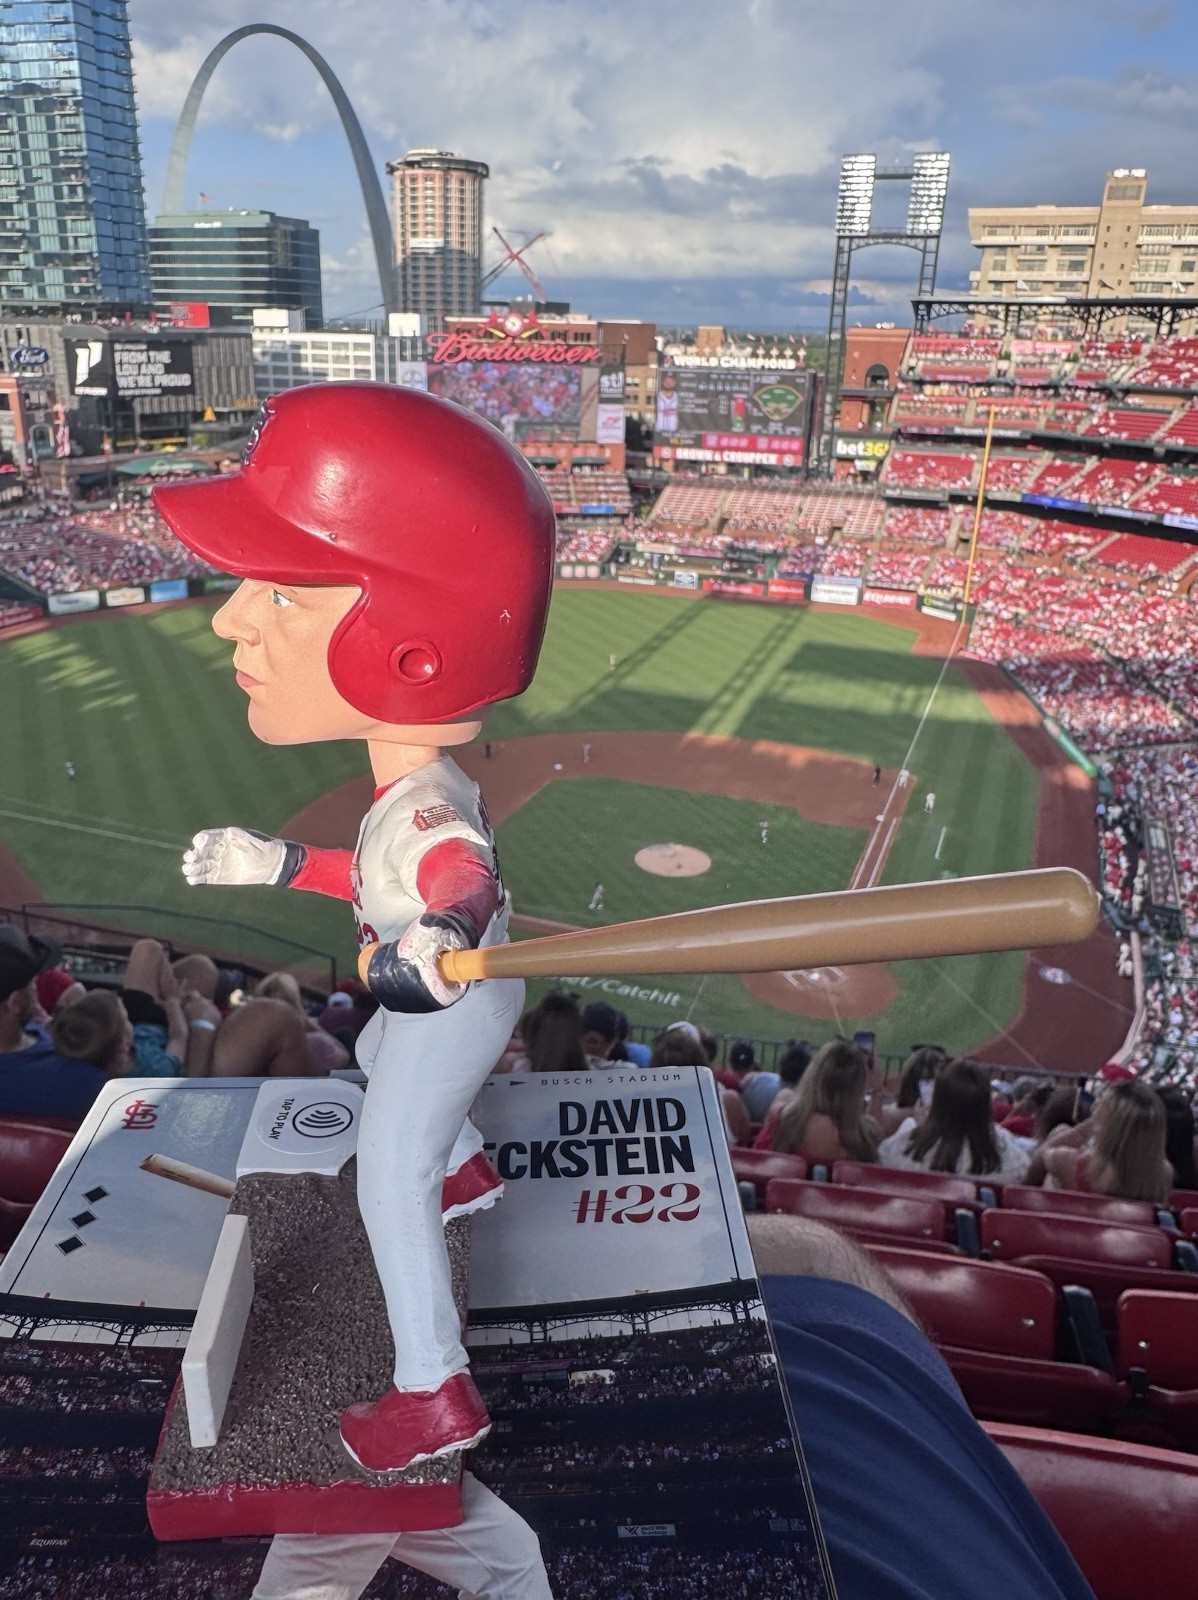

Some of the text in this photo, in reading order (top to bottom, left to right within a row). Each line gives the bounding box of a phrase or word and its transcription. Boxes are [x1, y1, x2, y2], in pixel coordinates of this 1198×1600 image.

[426, 332, 599, 364] Budweiser
[20, 349, 46, 364] Ford
[114, 350, 172, 364] FROM THE
[673, 354, 797, 370] WORLD CHAMPIONS
[115, 363, 165, 376] LOU AND
[154, 373, 192, 387] PROUD
[541, 1073, 682, 1086] BUSCH STADIUM
[268, 1098, 295, 1140] TAP TO PLAY
[558, 1097, 687, 1136] DAVID
[571, 1182, 701, 1224] #22
[29, 1539, 70, 1547] EQUIFAX
